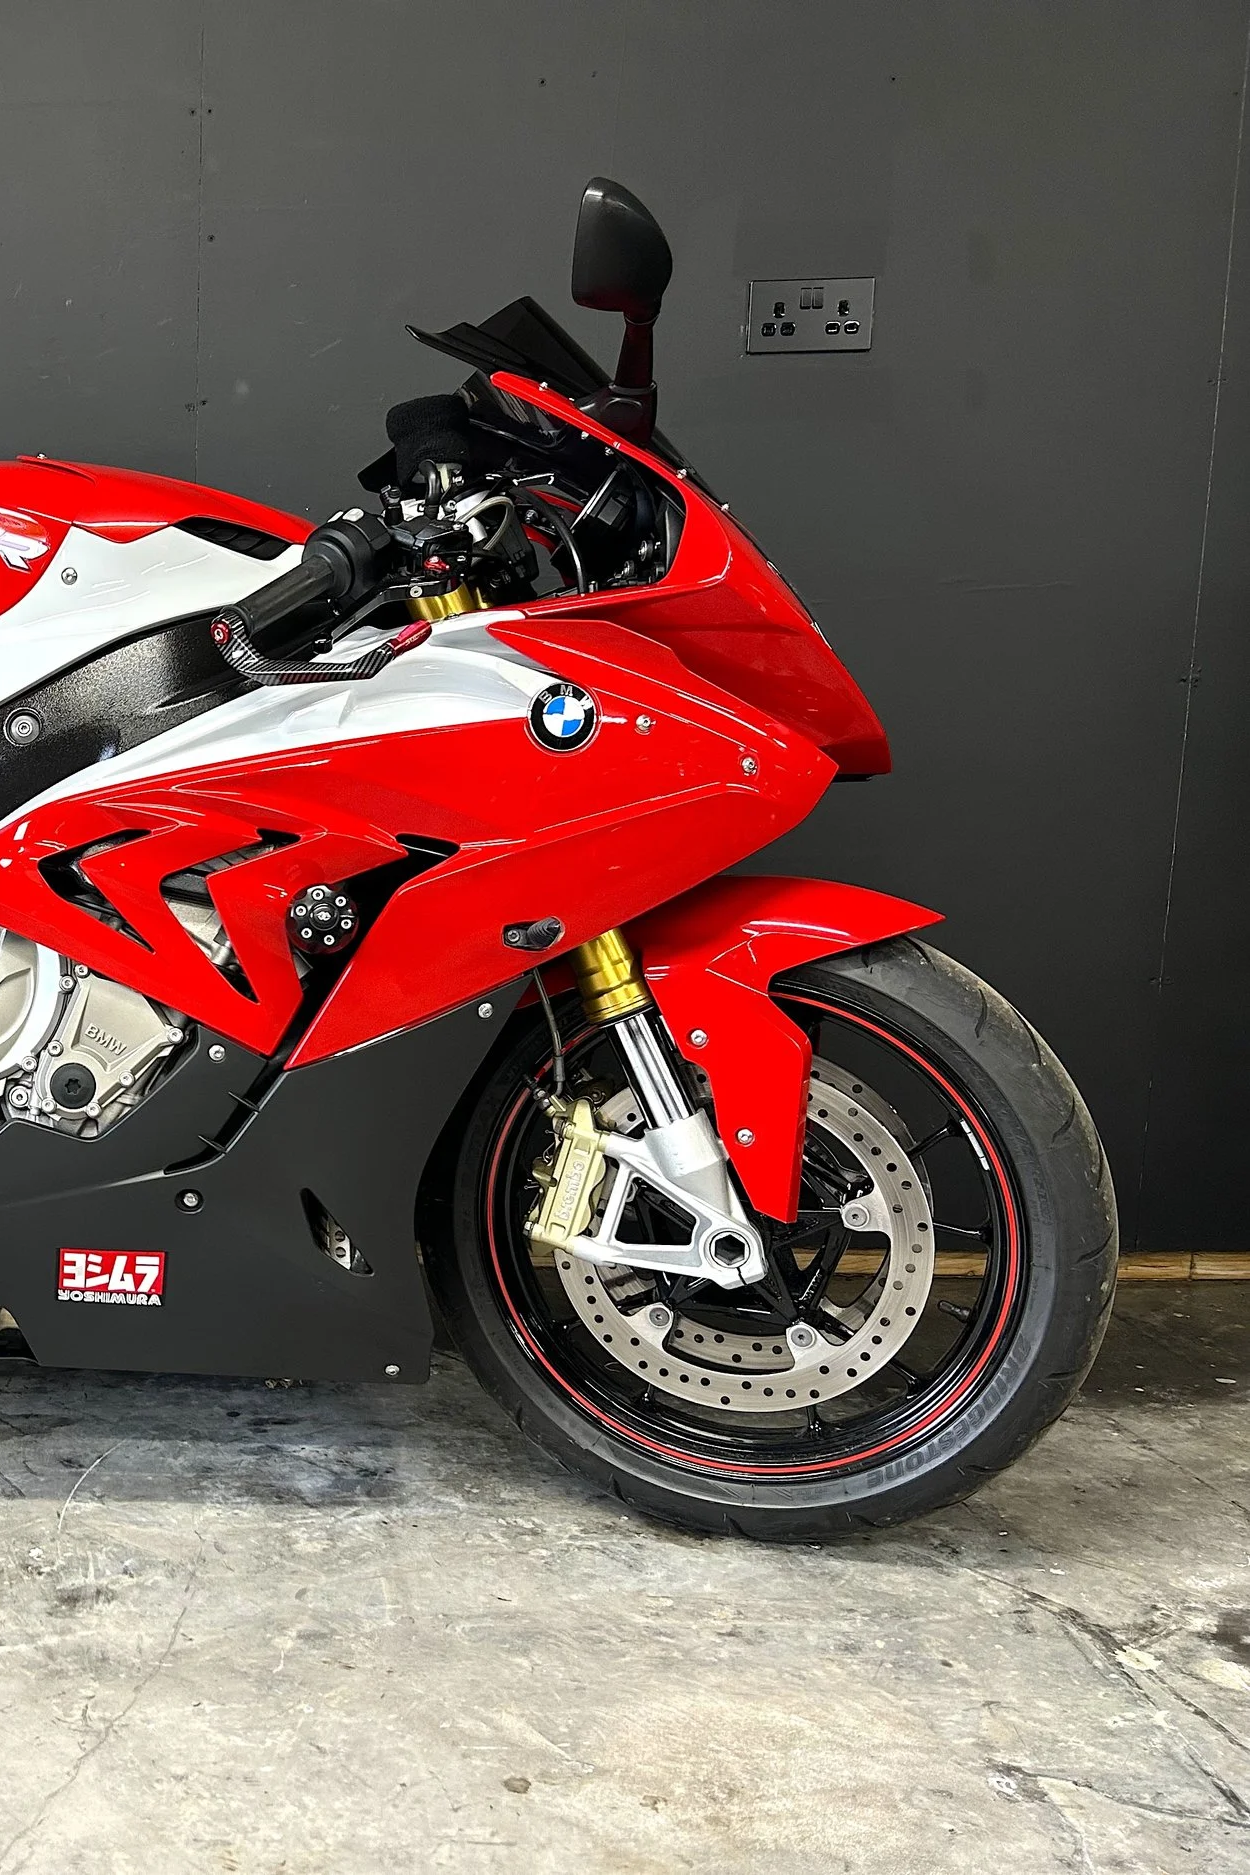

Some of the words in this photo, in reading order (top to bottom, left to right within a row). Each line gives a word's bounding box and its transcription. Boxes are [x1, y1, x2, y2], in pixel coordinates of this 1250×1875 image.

[538, 684, 594, 711] BMW
[85, 1022, 127, 1056] BMW
[554, 1161, 585, 1221] brembo
[63, 1252, 160, 1292] ヨシムラ
[57, 1289, 162, 1306] YOSHIMURA
[867, 1332, 1032, 1488] BRIDGESTONE
